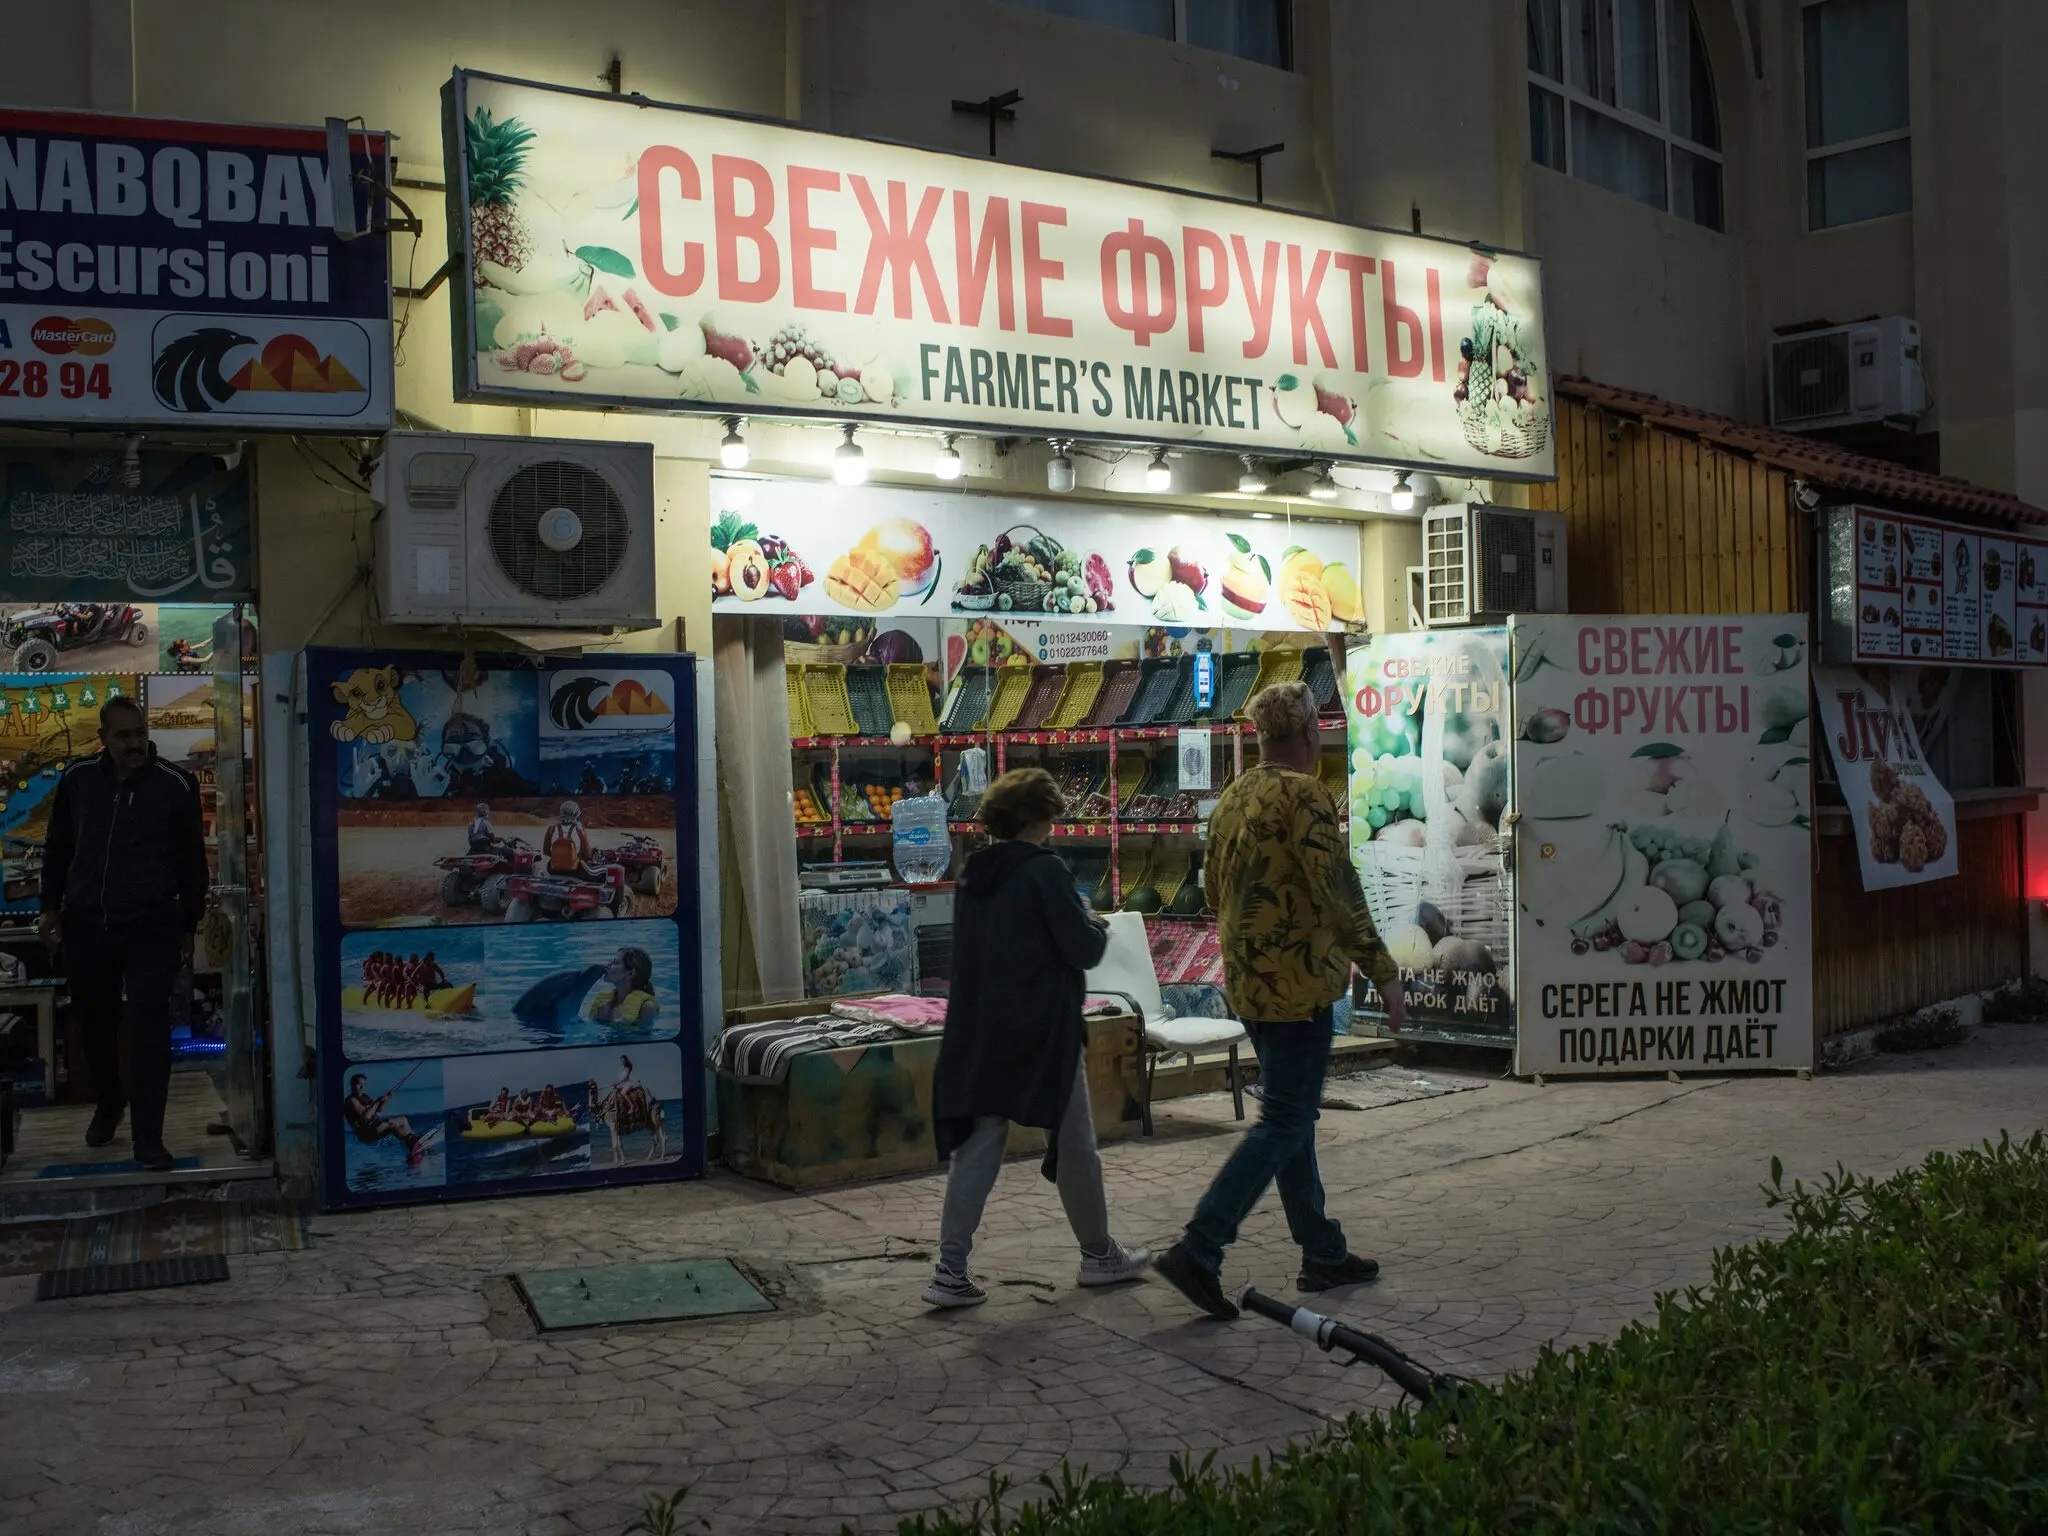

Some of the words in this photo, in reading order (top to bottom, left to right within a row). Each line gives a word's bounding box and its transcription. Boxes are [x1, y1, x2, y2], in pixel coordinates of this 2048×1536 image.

[637, 144, 1074, 338] СВЕЖИЕ
[1100, 217, 1446, 383] ФРУКТЫ
[33, 328, 114, 344] MasterCard
[60, 362, 112, 399] 94
[919, 342, 1113, 417] FARMER'S
[1124, 365, 1263, 430] MARKET
[1049, 630, 1108, 645] 01012430060
[1049, 645, 1109, 659] 01022377648
[1578, 626, 1744, 676] СВЕЖИЕ
[1383, 654, 1471, 679] СВЕЖИЕ
[1355, 680, 1501, 718] ФРУКТЫ
[1573, 685, 1750, 735] ФРУКТЫ
[1423, 968, 1445, 985] НЕ
[1452, 970, 1503, 988] ЖМО
[1366, 987, 1447, 1009] ПАРОК
[1454, 992, 1499, 1014] ДАЁТ
[1542, 982, 1647, 1019] СЕРЕГА
[1656, 980, 1692, 1016] НЕ
[1699, 979, 1787, 1014] ЖМОТ
[1559, 1026, 1695, 1066] ПОДАРКИ
[1703, 1019, 1778, 1063] ДАЁТ
